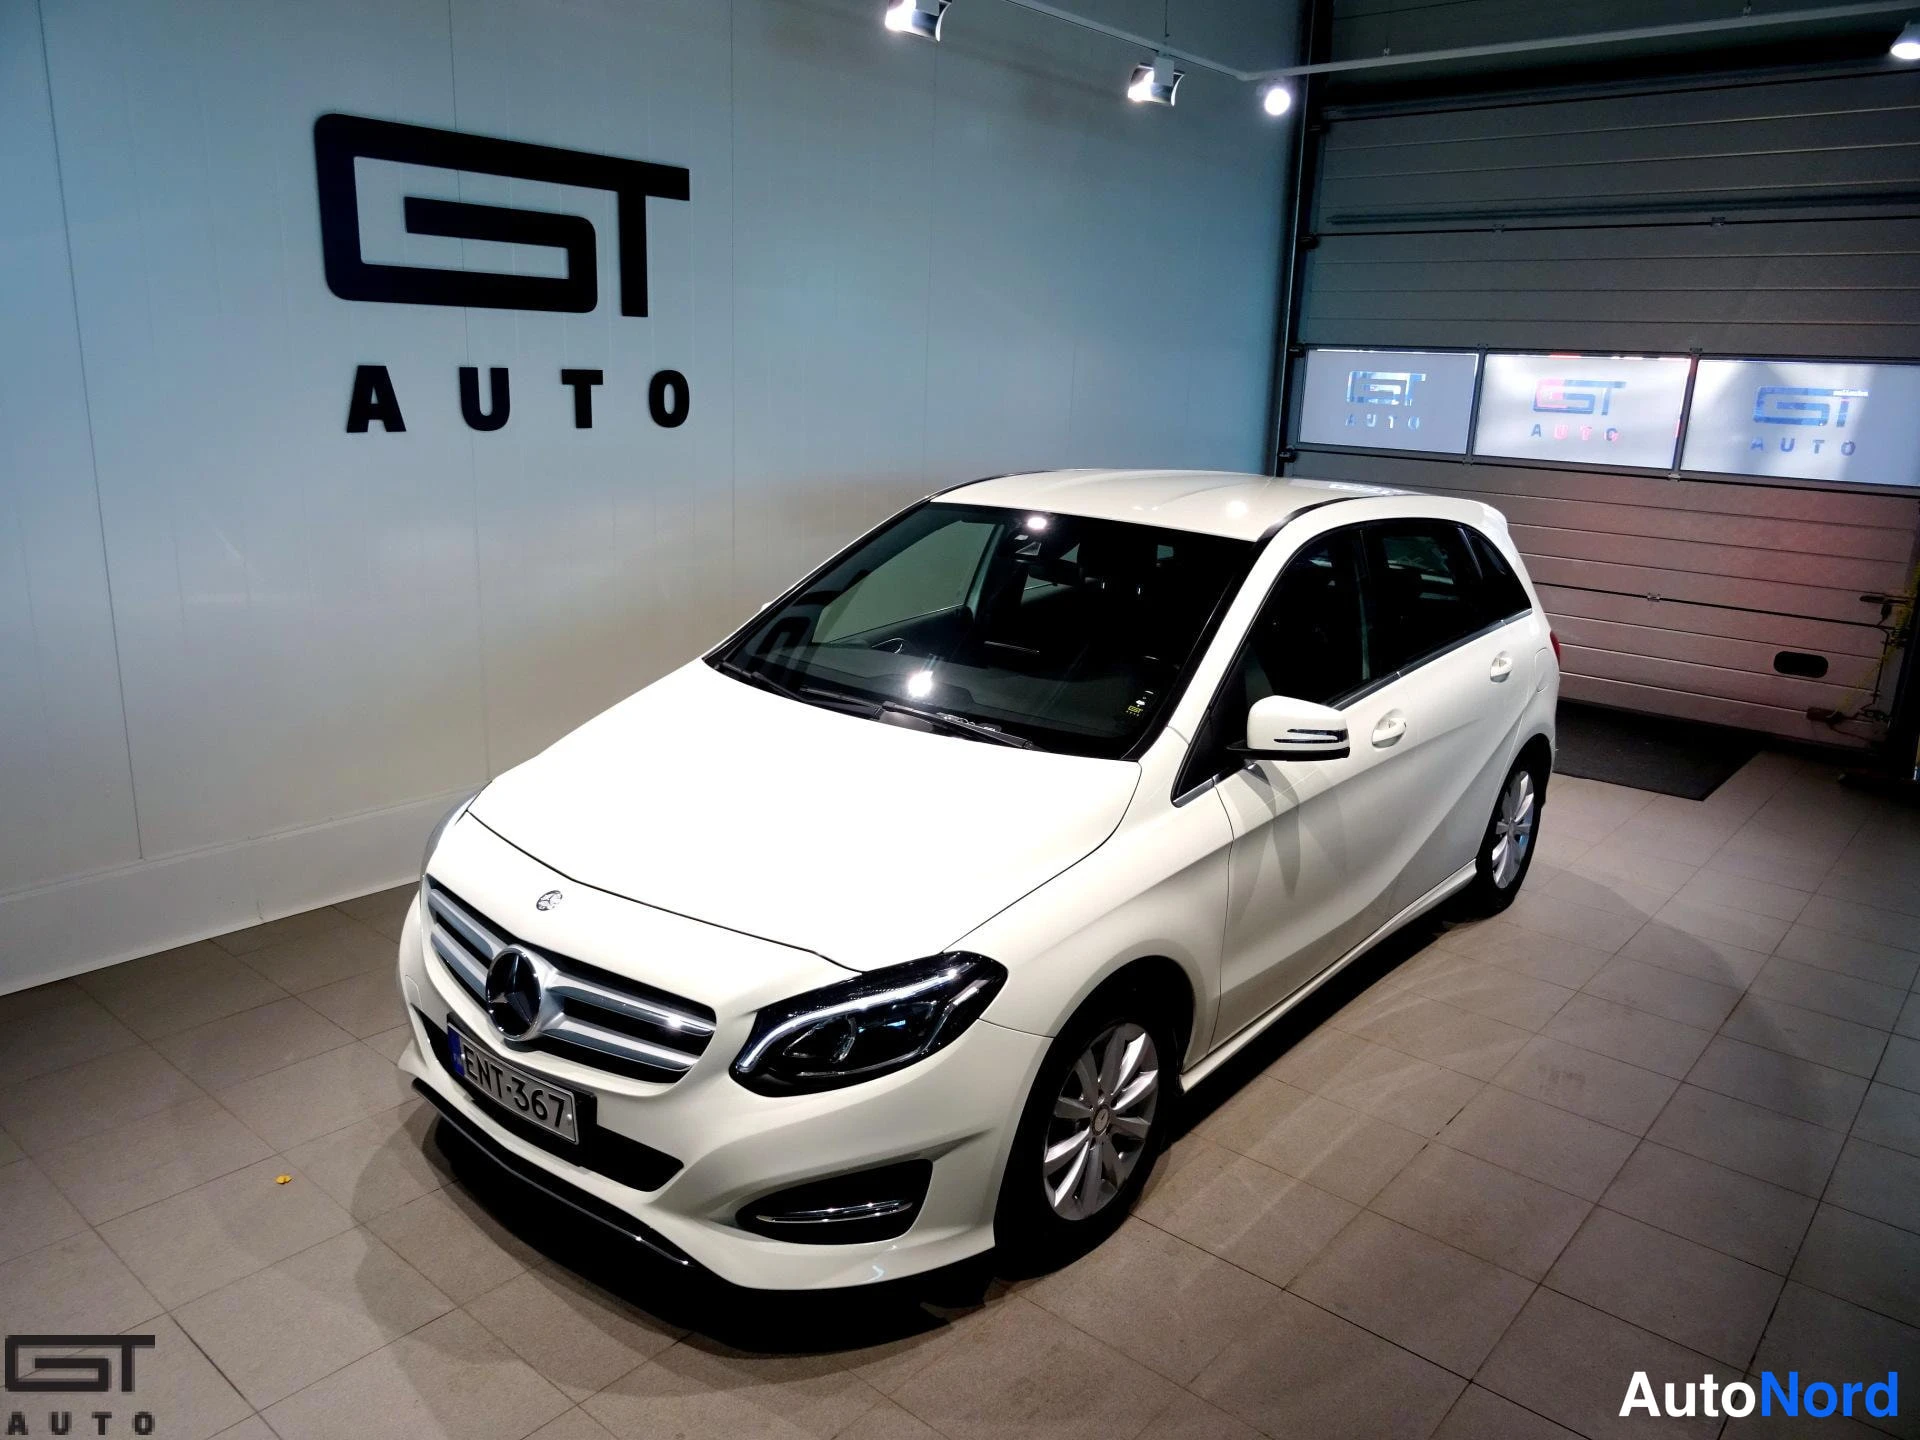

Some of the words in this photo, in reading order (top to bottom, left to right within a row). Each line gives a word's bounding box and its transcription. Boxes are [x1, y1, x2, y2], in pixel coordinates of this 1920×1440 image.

[346, 364, 690, 433] AUTO
[1345, 413, 1420, 430] AUTO
[1751, 437, 1856, 456] AUTO
[463, 1045, 565, 1129] ENT-367
